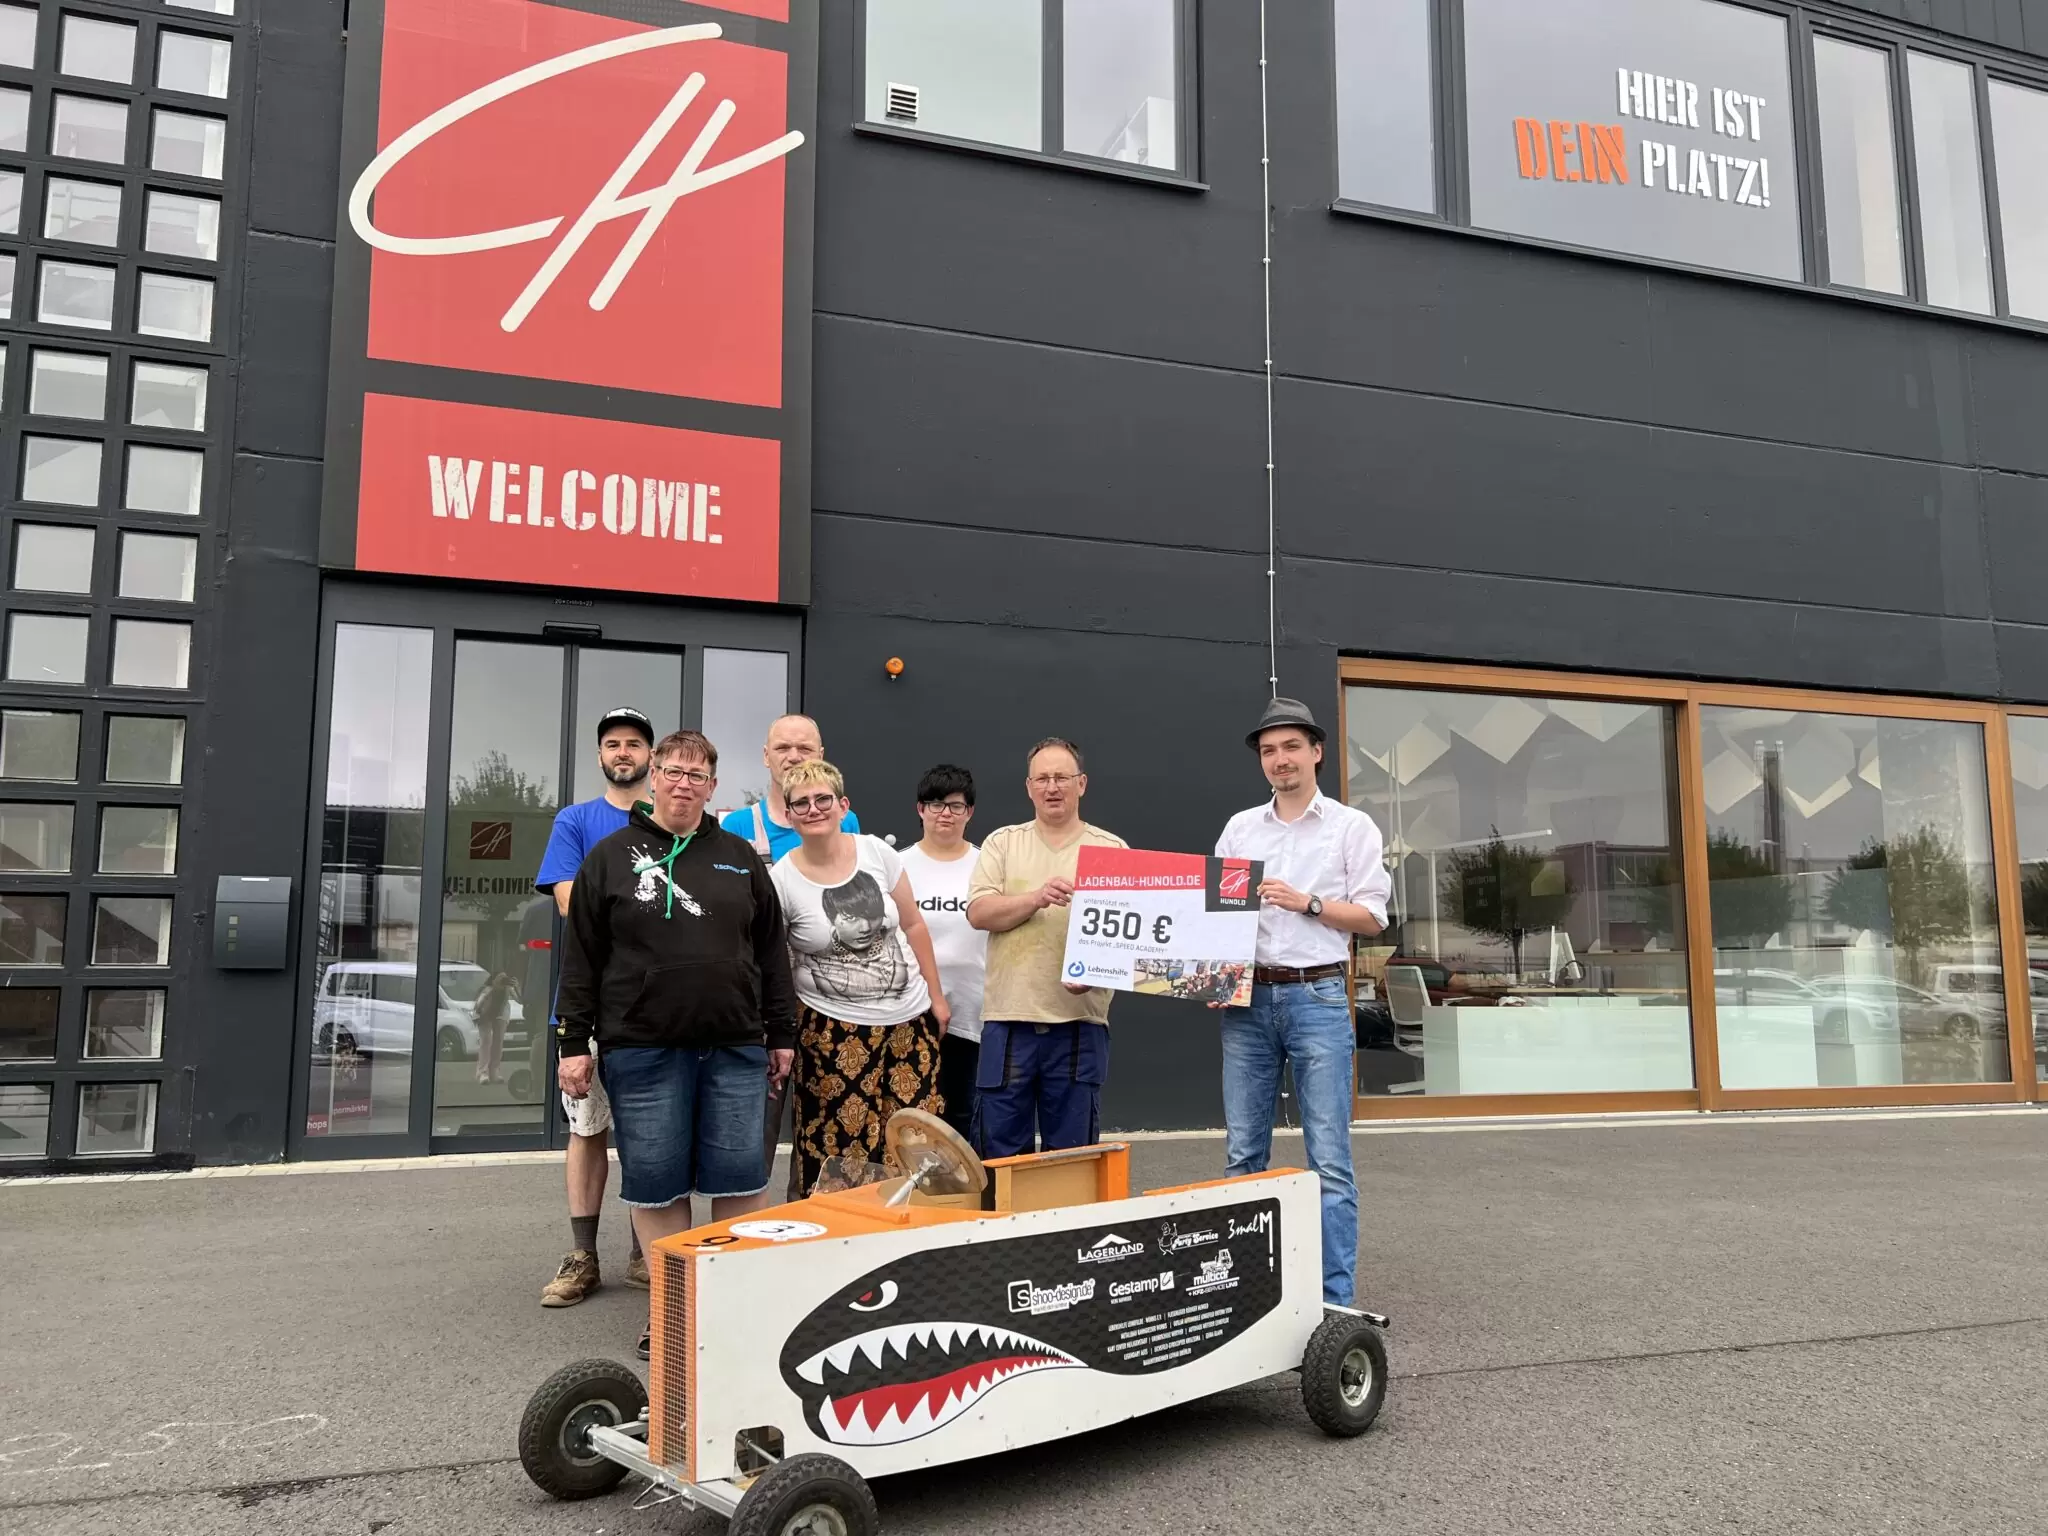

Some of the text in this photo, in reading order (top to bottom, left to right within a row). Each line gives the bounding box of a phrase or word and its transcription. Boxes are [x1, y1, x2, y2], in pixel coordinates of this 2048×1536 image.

[1616, 68, 1766, 141] HIER IST
[1513, 117, 1771, 208] DEIN PLATZ!
[427, 455, 723, 545] WELCOME
[446, 876, 535, 897] ELCOME
[1078, 874, 1201, 887] LADENBAU-HUNOLD.DE
[916, 897, 972, 912] did
[1220, 897, 1246, 906] HUNOLD
[1081, 907, 1173, 944] 350 €
[1087, 965, 1129, 976] Lebenshilfe
[1193, 1231, 1219, 1245] Service
[1077, 1243, 1144, 1261] LAGERLAND
[1109, 1278, 1159, 1297] Gestamp
